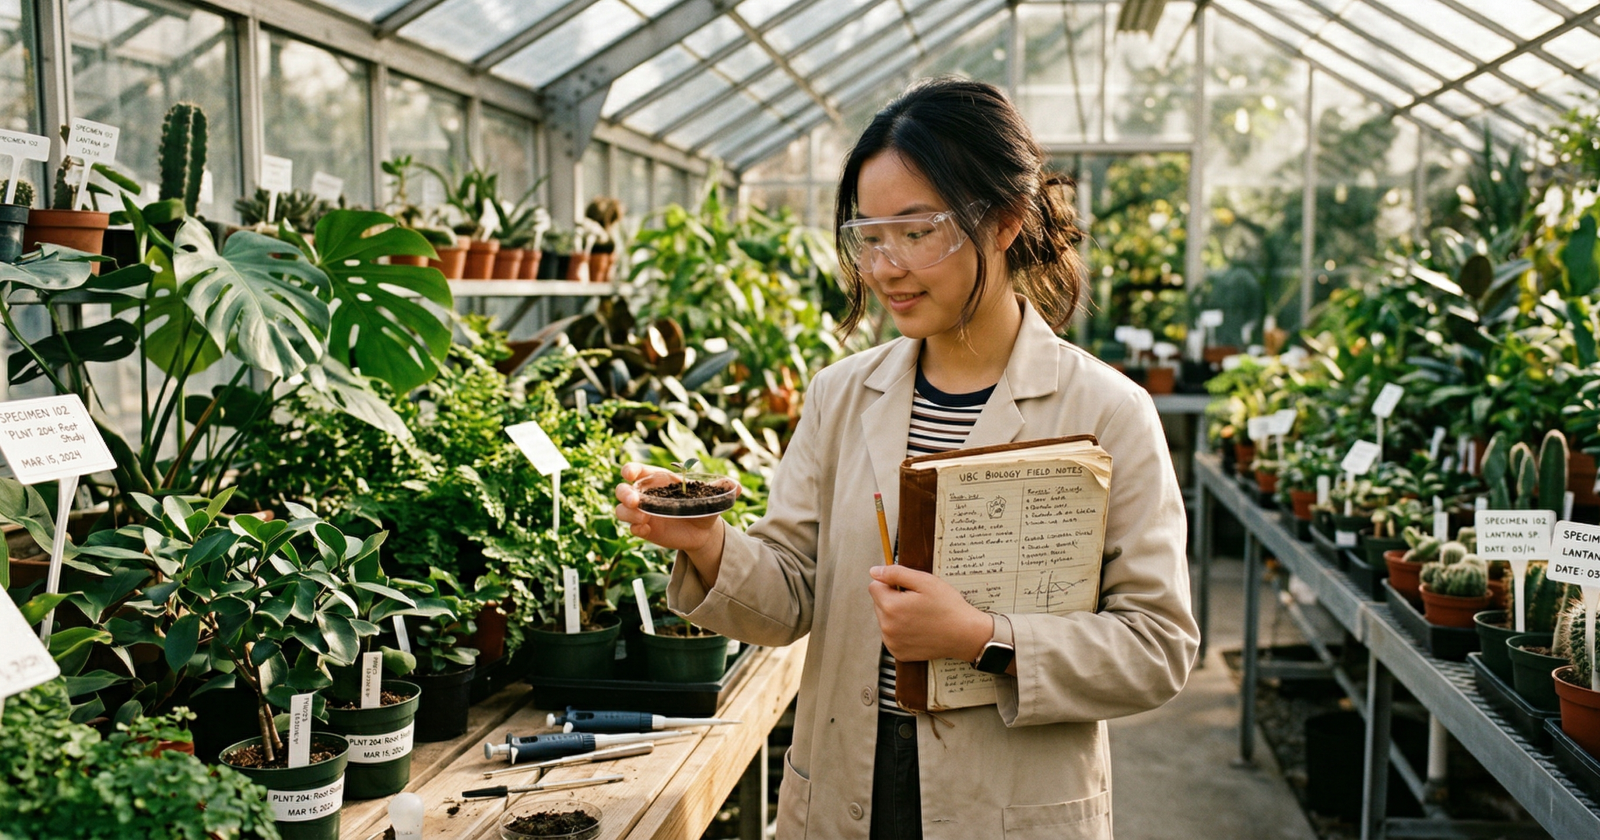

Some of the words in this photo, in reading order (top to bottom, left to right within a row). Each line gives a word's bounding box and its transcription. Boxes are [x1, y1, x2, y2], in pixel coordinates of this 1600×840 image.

[52, 405, 71, 417] 102
[21, 456, 45, 469] MAR
[60, 449, 83, 463] 2024
[959, 472, 979, 483] UBC
[985, 470, 1021, 480] BIOLOGY
[1027, 468, 1051, 477] FIELD
[1055, 466, 1083, 475] NOTES
[1484, 517, 1528, 525] SPECIMEN
[1532, 517, 1548, 525] 102
[1485, 531, 1524, 539] LANTANA
[1555, 564, 1584, 576] DATE:
[273, 794, 294, 802] PLNT
[287, 808, 306, 816] MAR
